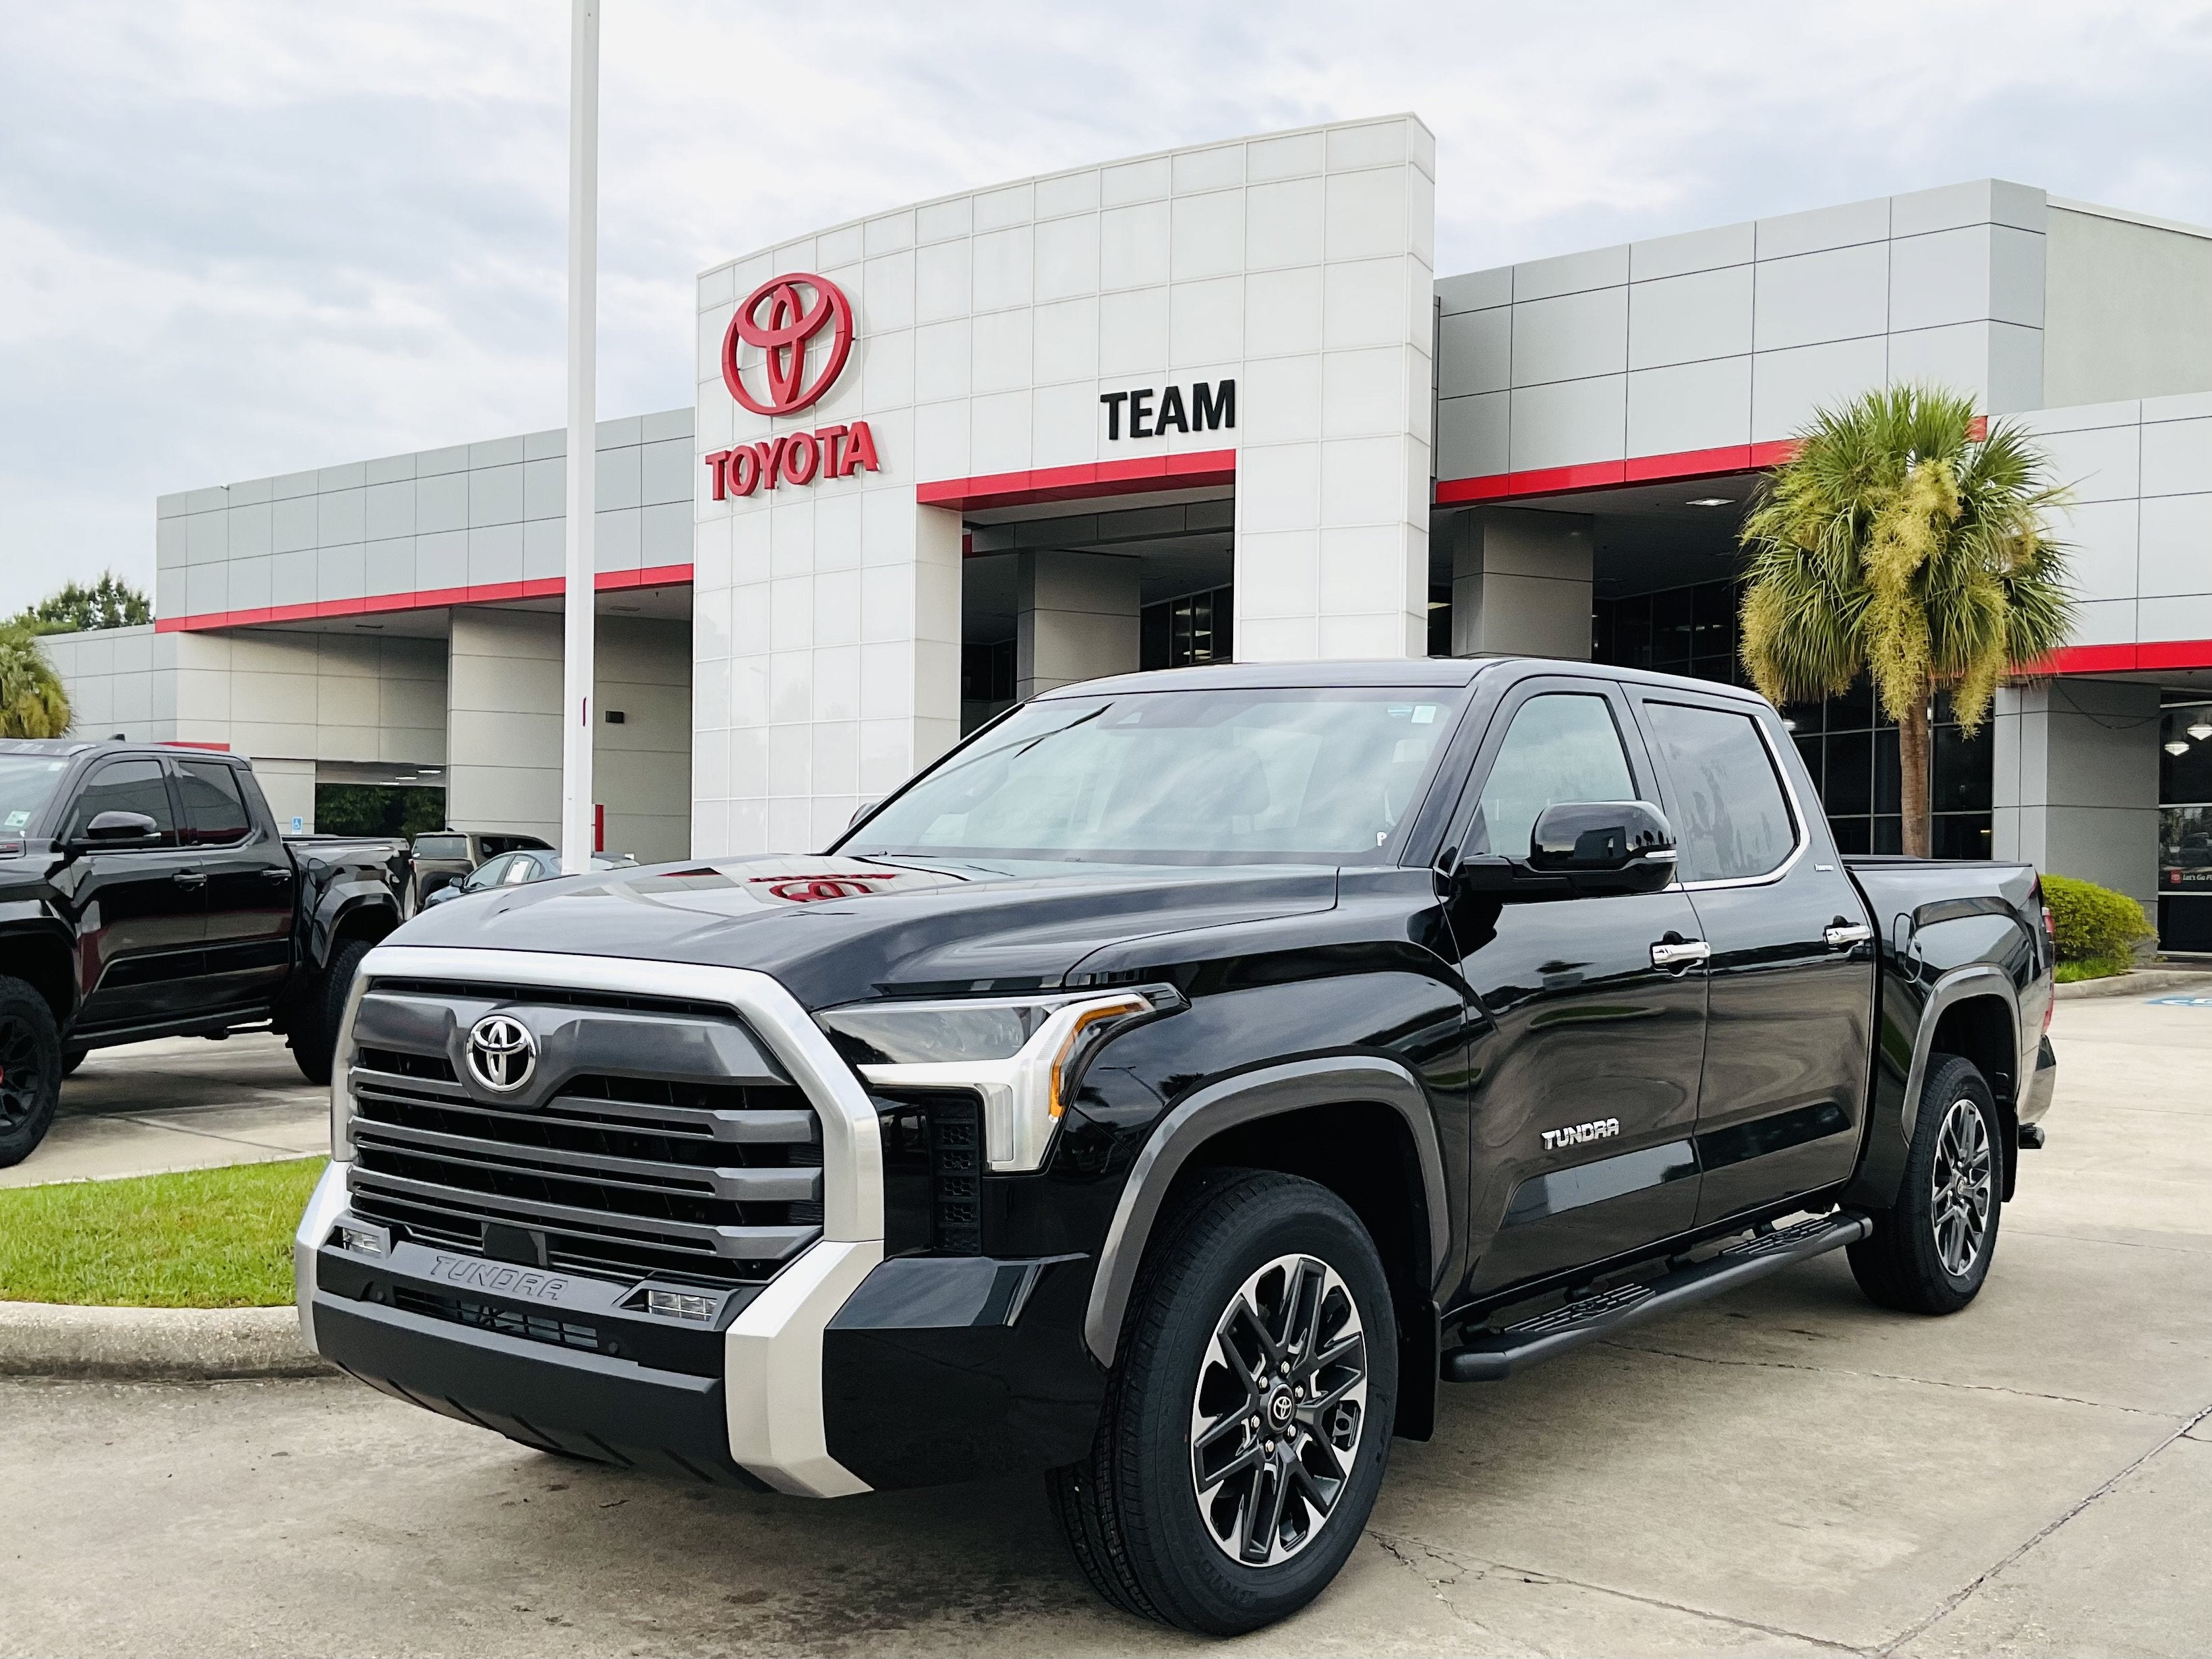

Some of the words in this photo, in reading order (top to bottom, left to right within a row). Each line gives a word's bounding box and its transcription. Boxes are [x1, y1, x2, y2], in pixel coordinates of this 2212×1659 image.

[1100, 379, 1235, 440] TEAM
[705, 421, 879, 501] TOYOTA
[1541, 1117, 1619, 1150] TUNDRA
[430, 1256, 569, 1300] TUNDRA
